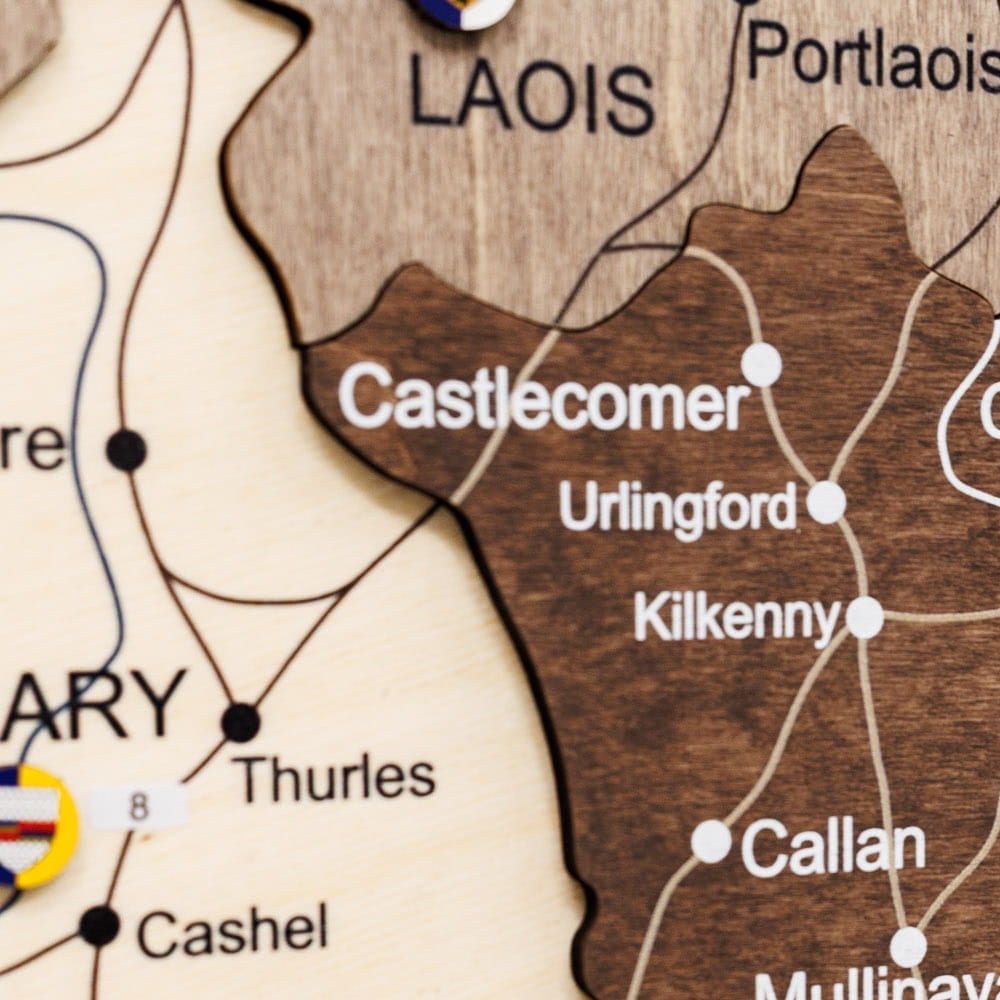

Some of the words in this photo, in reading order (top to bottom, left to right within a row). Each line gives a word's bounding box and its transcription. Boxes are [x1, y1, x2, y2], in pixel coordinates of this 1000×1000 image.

[411, 53, 655, 136] LAOIS
[338, 361, 752, 431] Castlecomer
[560, 480, 797, 542] Urlingford
[634, 590, 841, 649] Kilkenny
[130, 792, 149, 821] 8
[232, 753, 436, 804] Thurles
[741, 816, 926, 878] Callan
[138, 902, 328, 960] Cashel
